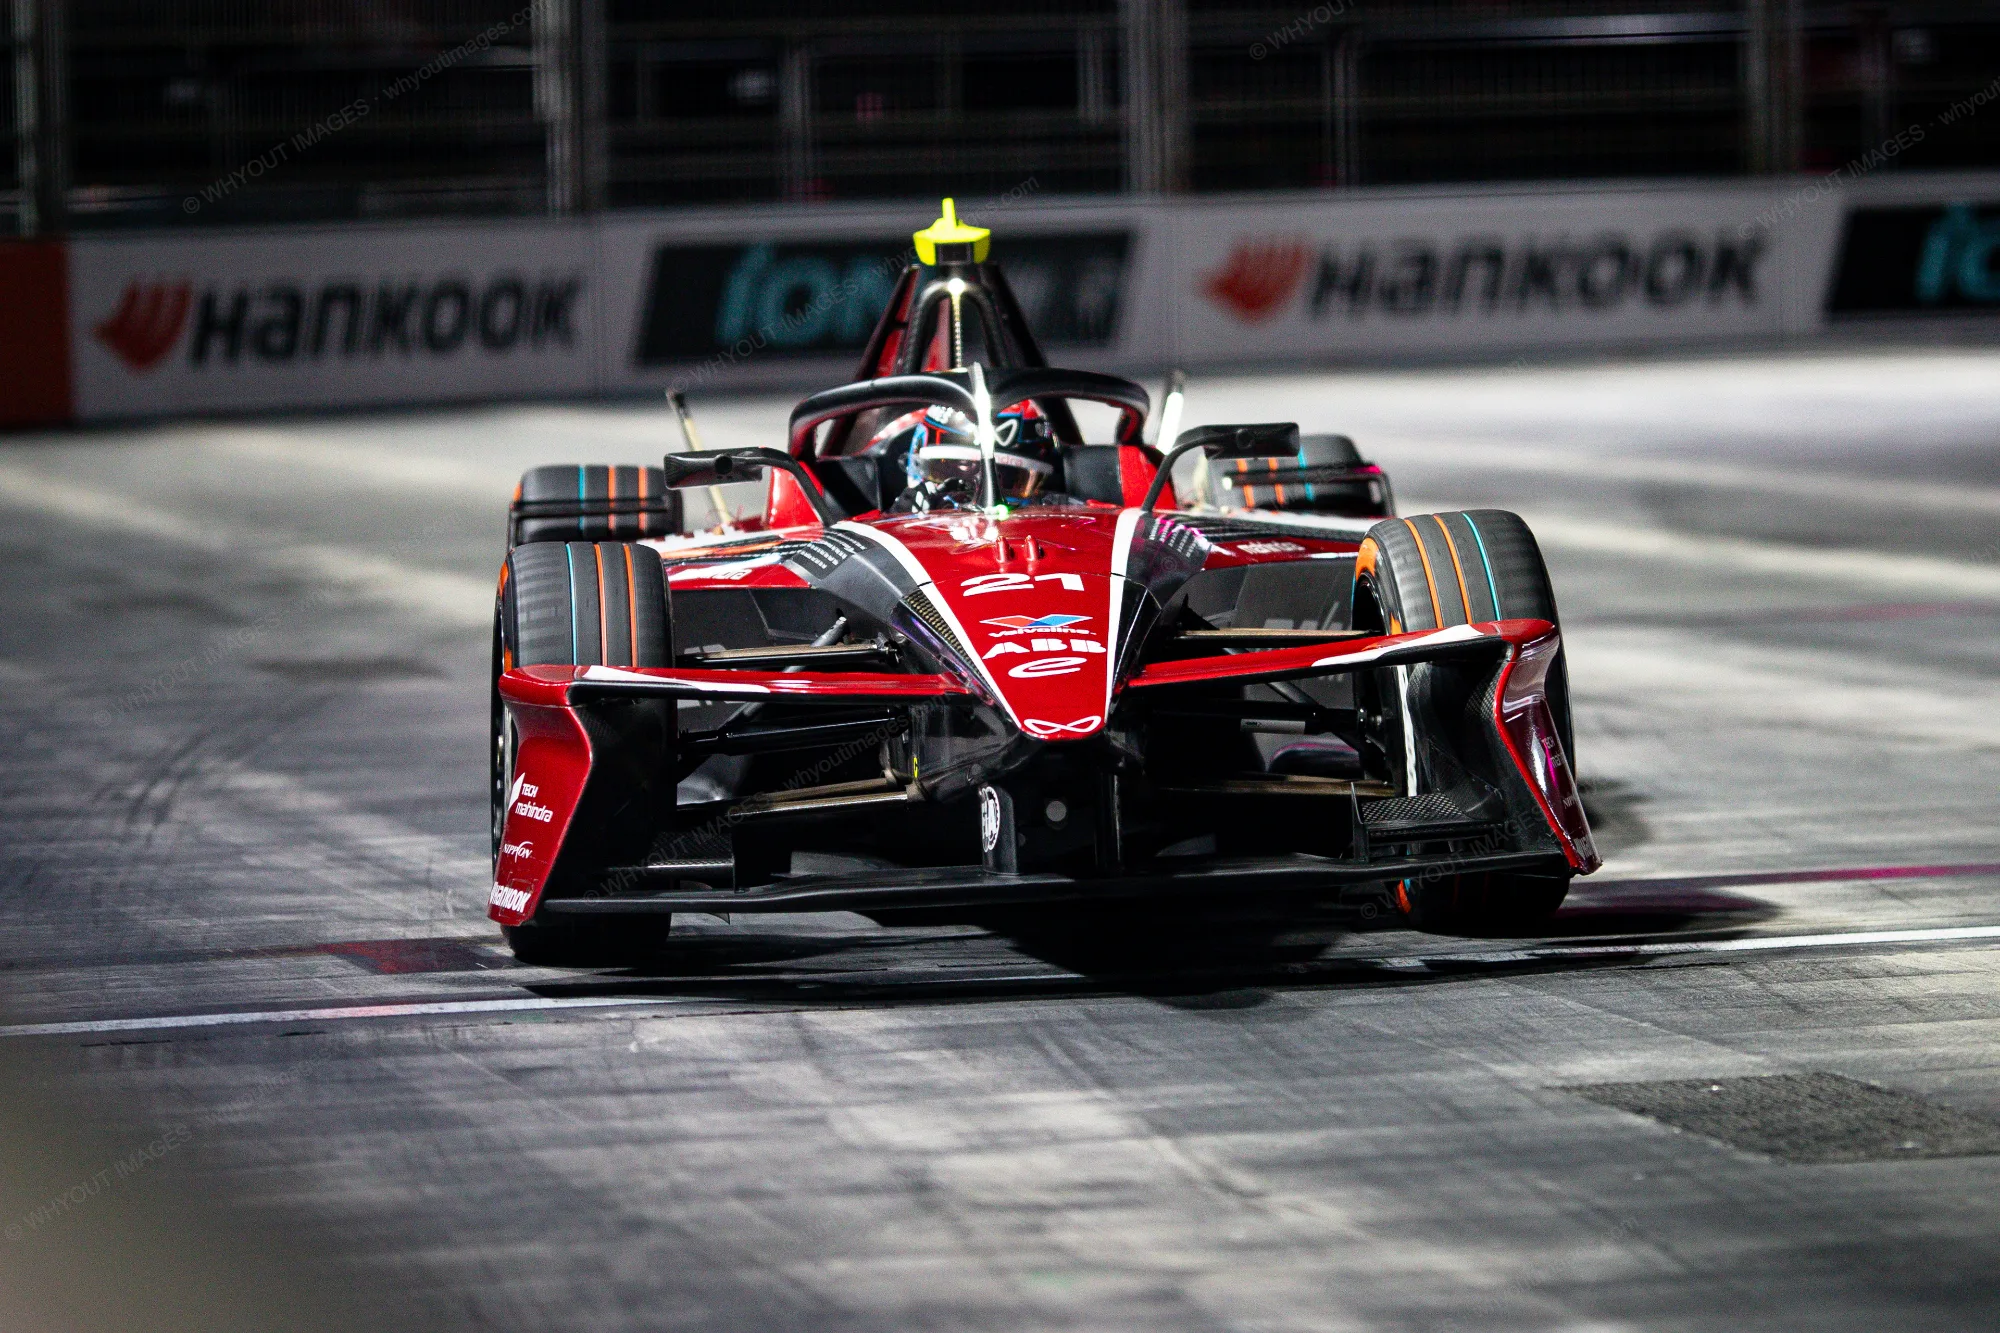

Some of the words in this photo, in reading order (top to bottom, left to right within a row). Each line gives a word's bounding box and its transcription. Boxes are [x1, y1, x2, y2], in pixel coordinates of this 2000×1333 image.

[960, 573, 1085, 597] 21
[982, 638, 1107, 660] ABB
[521, 783, 539, 797] TECH
[515, 801, 553, 823] mahindra
